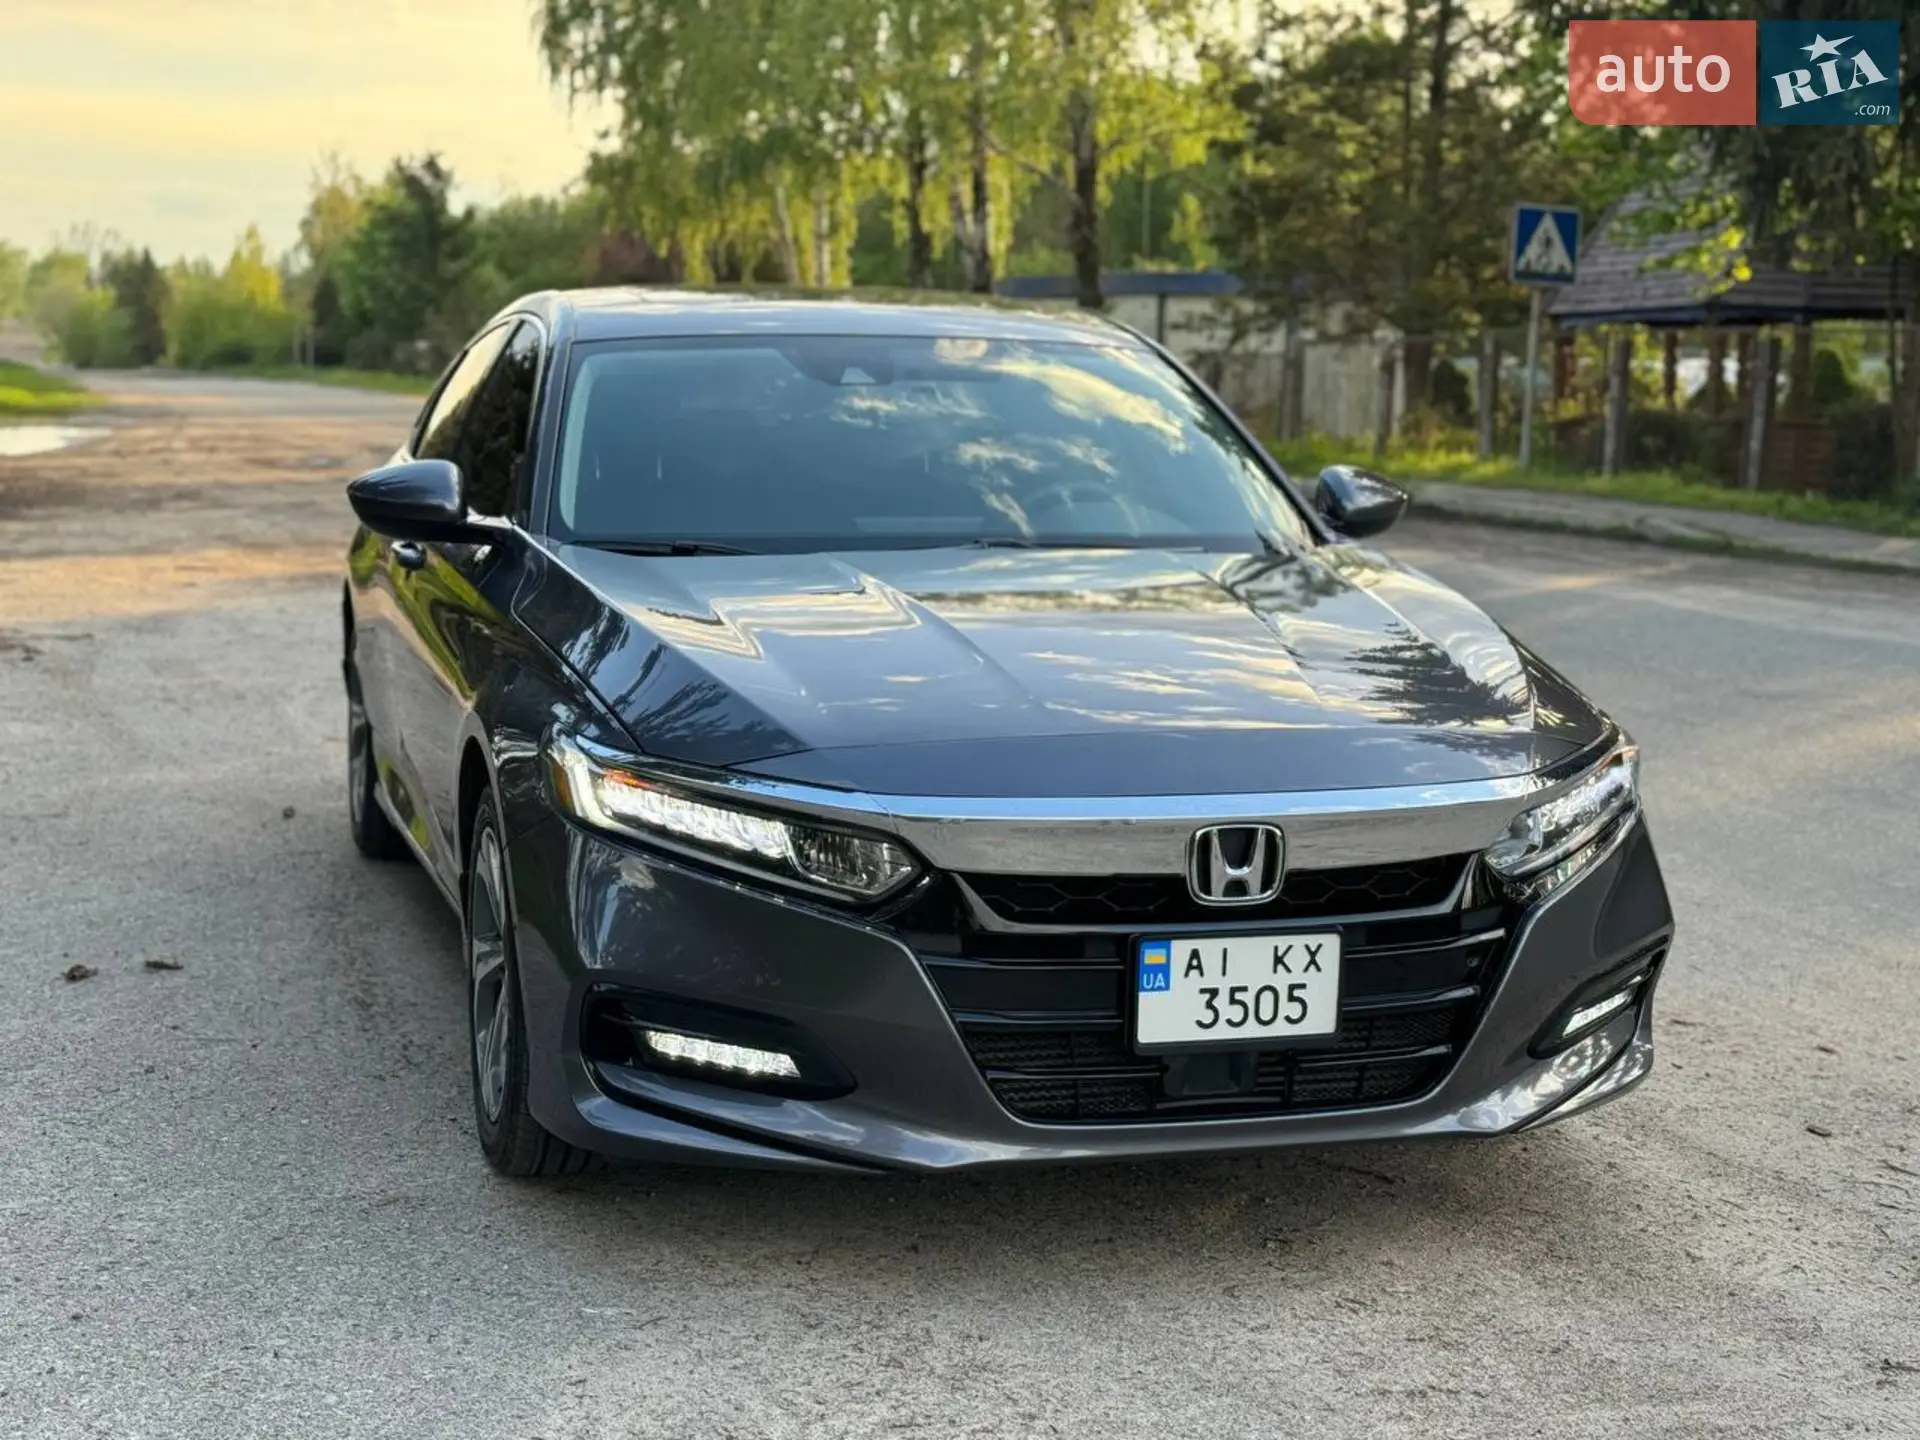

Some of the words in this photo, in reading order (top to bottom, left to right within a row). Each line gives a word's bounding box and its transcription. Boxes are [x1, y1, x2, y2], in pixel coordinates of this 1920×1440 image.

[1184, 948, 1228, 978] AI
[1272, 943, 1323, 974] KX
[1143, 973, 1166, 989] UA
[1195, 983, 1308, 1029] 3505
